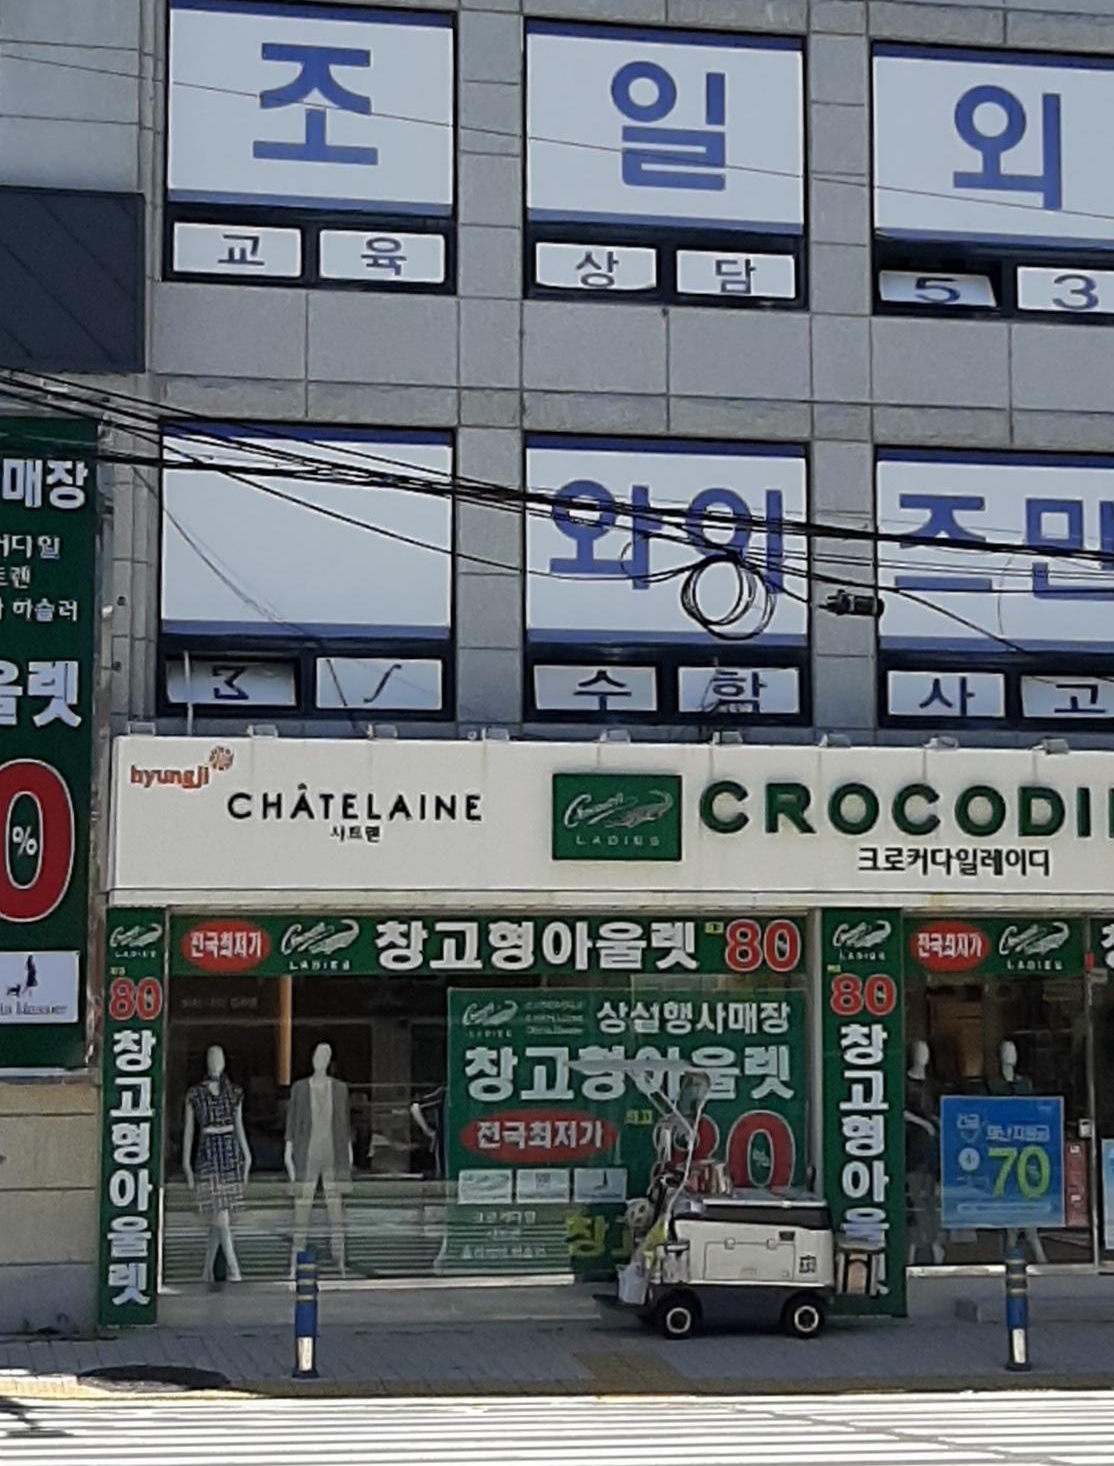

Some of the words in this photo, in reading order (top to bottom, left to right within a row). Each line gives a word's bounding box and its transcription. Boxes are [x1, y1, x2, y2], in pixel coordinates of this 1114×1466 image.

[217, 233, 407, 277] 교육
[575, 250, 757, 296] 상담
[858, 846, 1051, 877] 크로커다일레이디
[374, 920, 698, 971] 창고형아울렛
[596, 1000, 791, 1034] 상설행사매장
[477, 1120, 603, 1150] 전국최저가
[107, 1030, 157, 1306] 창고형아울렛
[987, 1144, 1051, 1201] 70
